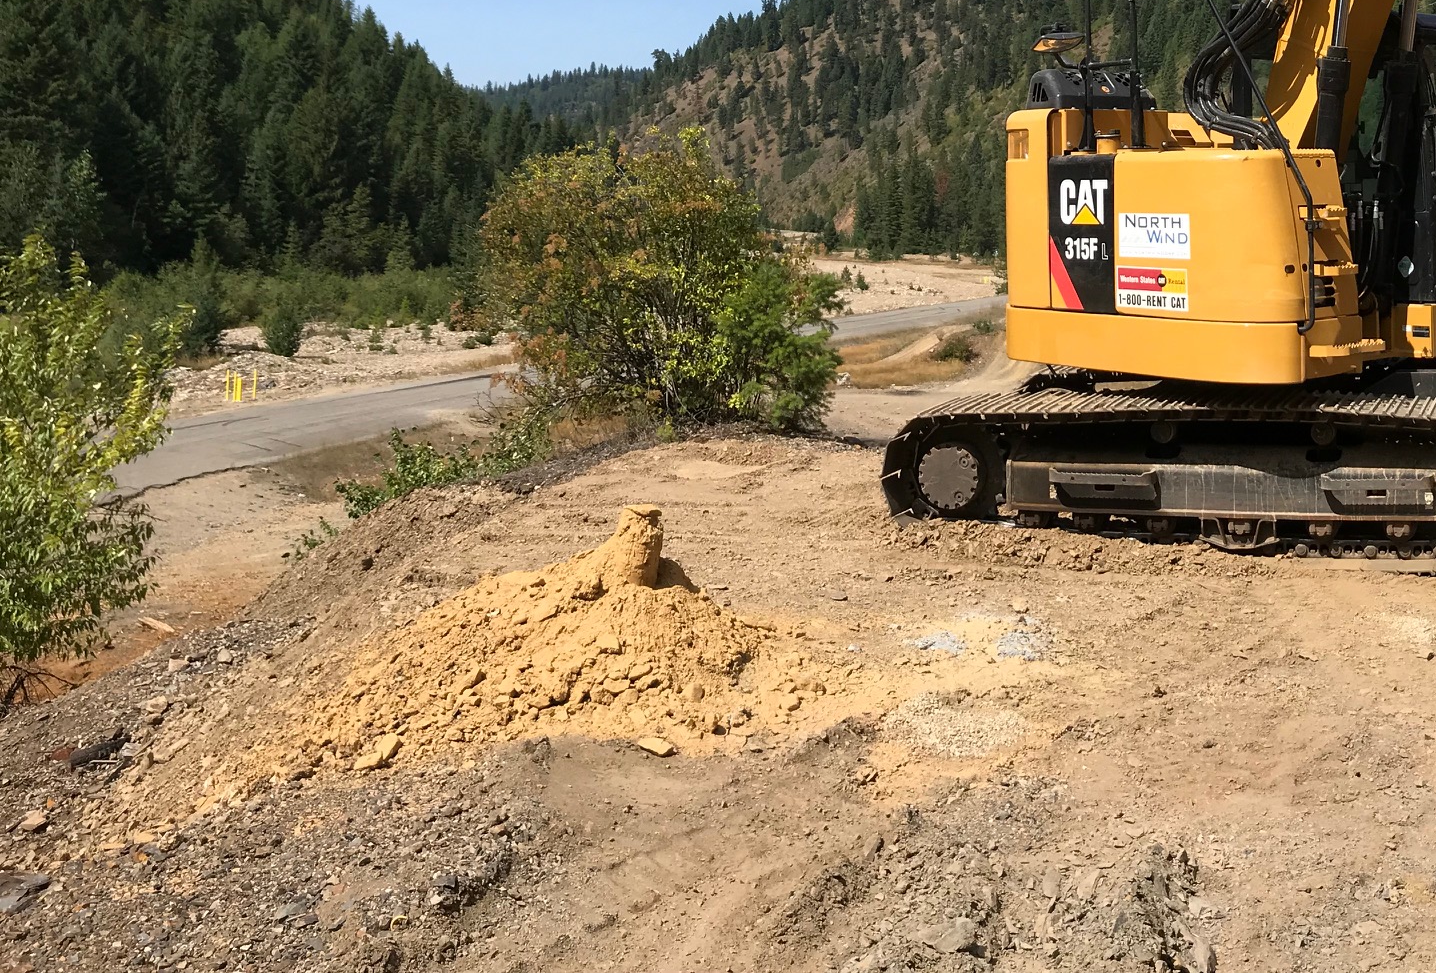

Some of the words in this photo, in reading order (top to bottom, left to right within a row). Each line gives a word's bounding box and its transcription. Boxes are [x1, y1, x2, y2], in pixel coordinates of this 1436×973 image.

[1060, 179, 1108, 225] CAT
[1064, 236, 1099, 260] 315F
[1101, 242, 1109, 261] L
[1119, 274, 1139, 283] Western
[1139, 275, 1156, 285] States
[1119, 293, 1167, 308] 1-800-RENT
[1171, 296, 1186, 309] CAT
